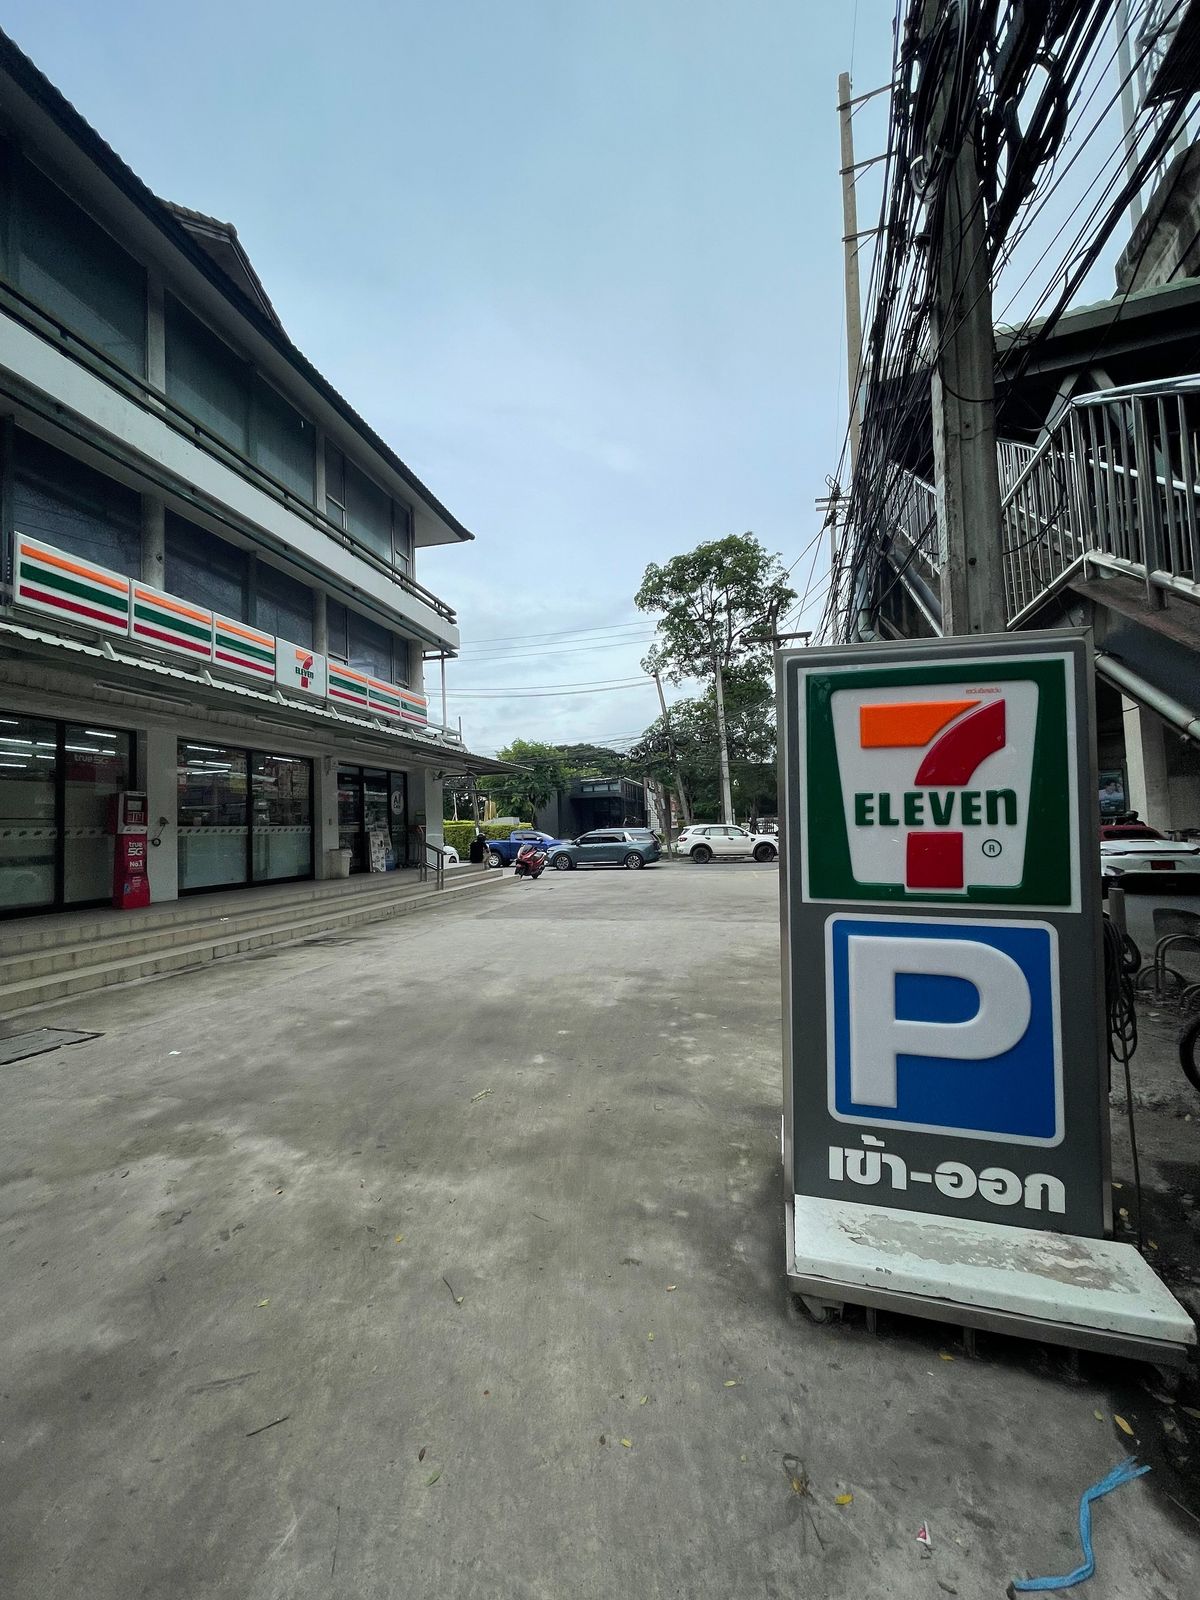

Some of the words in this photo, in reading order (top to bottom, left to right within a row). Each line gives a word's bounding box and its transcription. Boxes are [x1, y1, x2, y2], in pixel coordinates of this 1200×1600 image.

[127, 848, 143, 856] 5G
[848, 934, 1032, 1109] P
[828, 1133, 1066, 1214] เข้า-ออก
